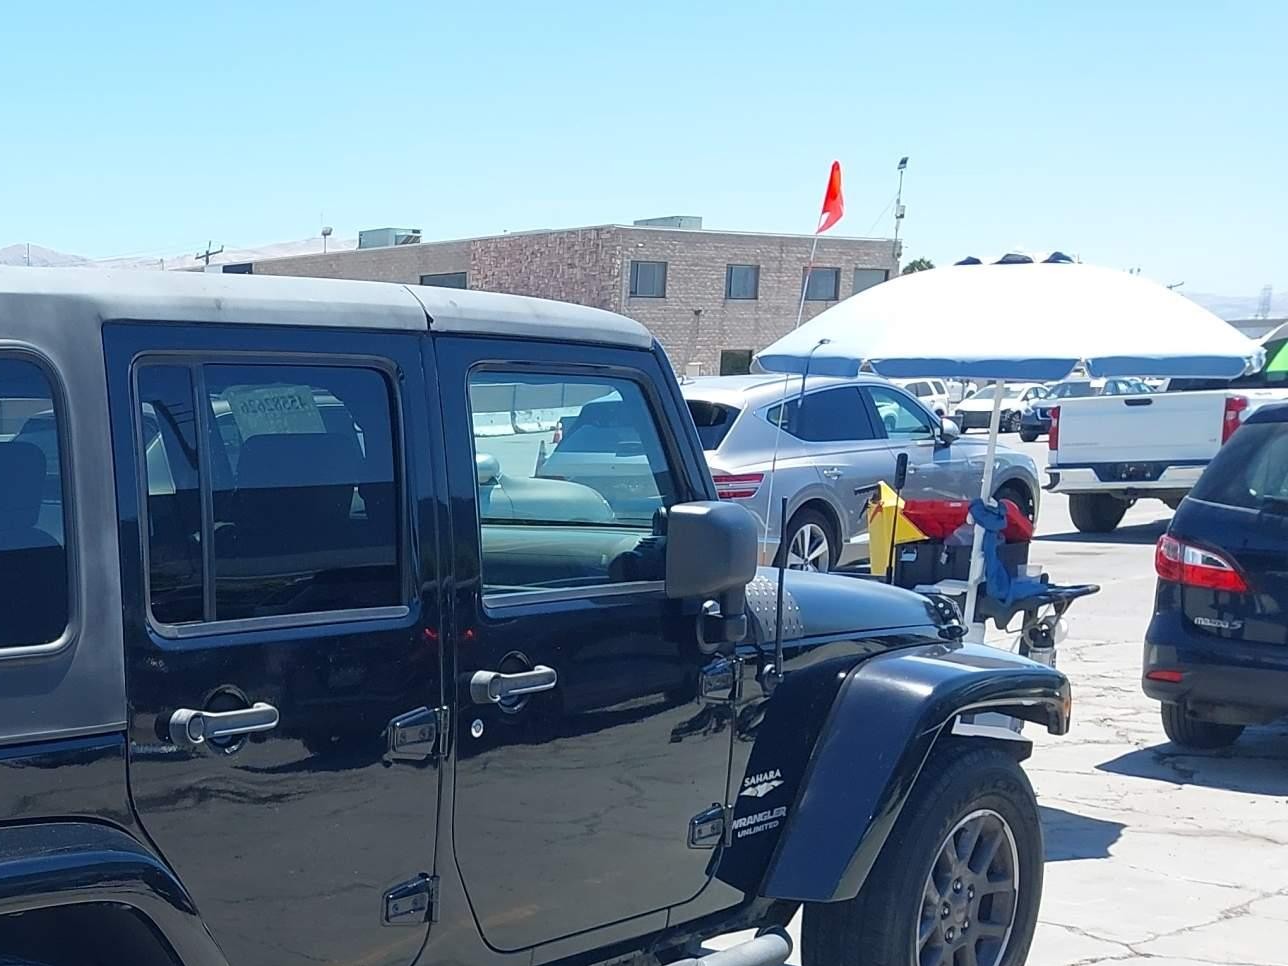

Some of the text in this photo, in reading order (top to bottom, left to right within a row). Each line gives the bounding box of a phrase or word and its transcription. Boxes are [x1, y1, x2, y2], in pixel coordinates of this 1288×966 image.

[744, 769, 781, 787] SAHARA
[732, 806, 787, 830] WRANGLER
[737, 821, 779, 838] UNLIMITED
